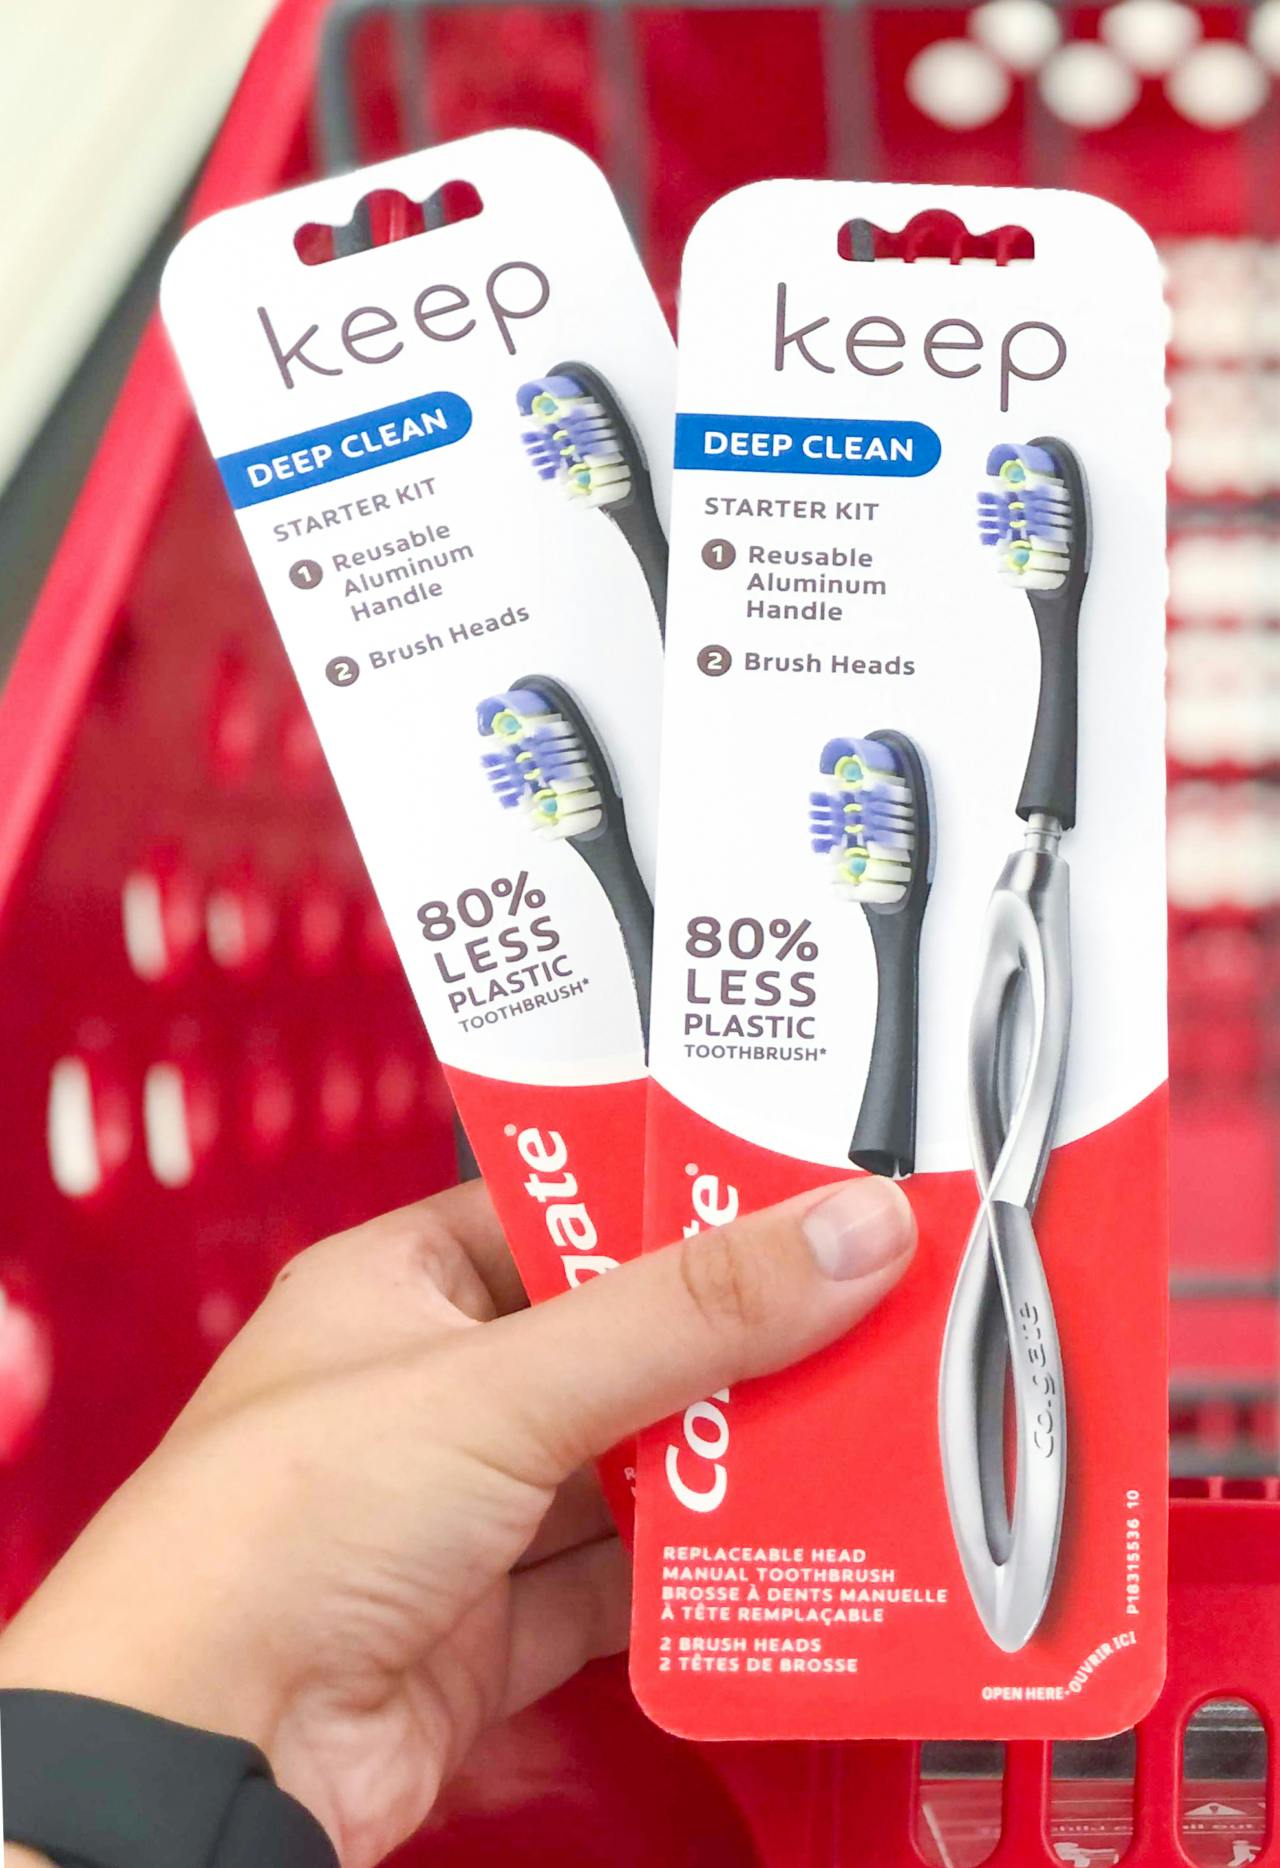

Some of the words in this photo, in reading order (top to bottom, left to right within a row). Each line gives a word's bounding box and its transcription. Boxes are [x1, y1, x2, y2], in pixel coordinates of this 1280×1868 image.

[257, 260, 550, 390] keep
[774, 282, 1067, 413] keep
[246, 443, 339, 489] DEEP
[340, 407, 449, 457] CLEAN
[704, 431, 793, 457] DEEP
[802, 435, 914, 461] CLEAN
[273, 492, 391, 543] STARTER
[396, 477, 438, 505] KIT
[704, 496, 827, 520] STARTER
[836, 502, 880, 521] KIT
[332, 521, 452, 573] Reusable
[748, 545, 873, 568] Reusable
[343, 542, 475, 598] Aluminum
[746, 572, 887, 596] Aluminum
[350, 579, 444, 623] Handle
[746, 600, 843, 622] Handle
[368, 633, 444, 670] Brush
[449, 605, 531, 644] Heads
[744, 651, 822, 673] Brush
[831, 654, 916, 676] Heads
[417, 870, 546, 942] 80%
[434, 915, 560, 984] LESS
[685, 916, 819, 962] 80%
[448, 954, 573, 1013] PLASTIC
[686, 968, 816, 1008] LESS
[684, 1013, 816, 1040] PLASTIC
[662, 1566, 749, 1583] MANUAL
[756, 1567, 896, 1584] TOOTHBRUSH
[663, 1546, 804, 1563] REPLACEABLE
[811, 1548, 867, 1564] HEAD
[1126, 1517, 1141, 1616] P18315536
[660, 1603, 675, 1621] À
[681, 1602, 731, 1622] TÊTE
[737, 1606, 885, 1626] REMPLAÇABLE
[661, 1586, 740, 1602] BROSSE
[747, 1583, 761, 1602] À
[767, 1587, 834, 1603] DENTS
[840, 1588, 948, 1604] MANUELLE
[658, 1656, 672, 1672] 2
[678, 1652, 740, 1673] TÊTES
[746, 1657, 773, 1673] DE
[779, 1657, 859, 1674] BROSSE
[659, 1636, 672, 1652] 2
[679, 1637, 747, 1653] BRUSH
[754, 1637, 822, 1653] HEADS
[981, 1686, 1023, 1700] OPEN
[1112, 1631, 1138, 1651] ICI
